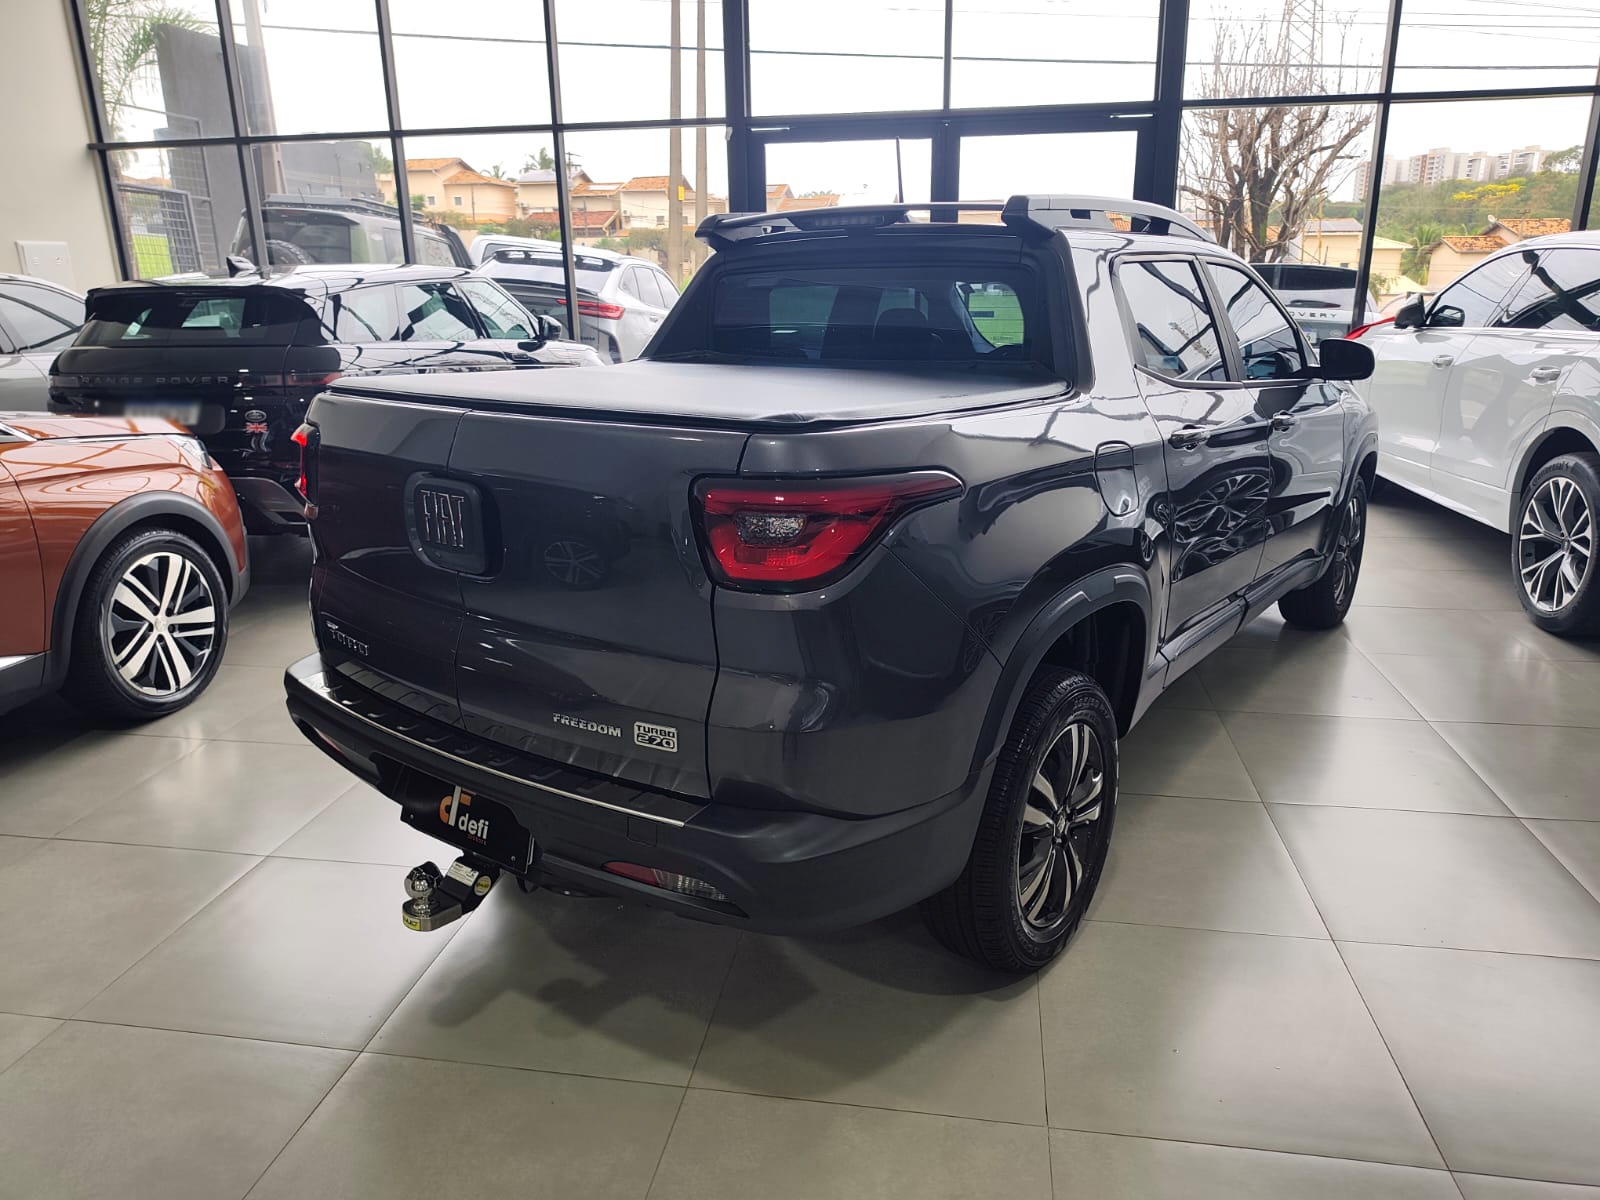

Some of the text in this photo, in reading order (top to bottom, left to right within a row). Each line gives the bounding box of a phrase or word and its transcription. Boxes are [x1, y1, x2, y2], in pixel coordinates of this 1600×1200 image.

[81, 376, 229, 385] RANGE ROVER
[420, 489, 465, 547] FIAT
[329, 628, 369, 657] TORO
[553, 712, 622, 738] FREEDOM
[635, 723, 677, 739] TURBO
[636, 732, 676, 750] 270
[458, 812, 489, 840] defi
